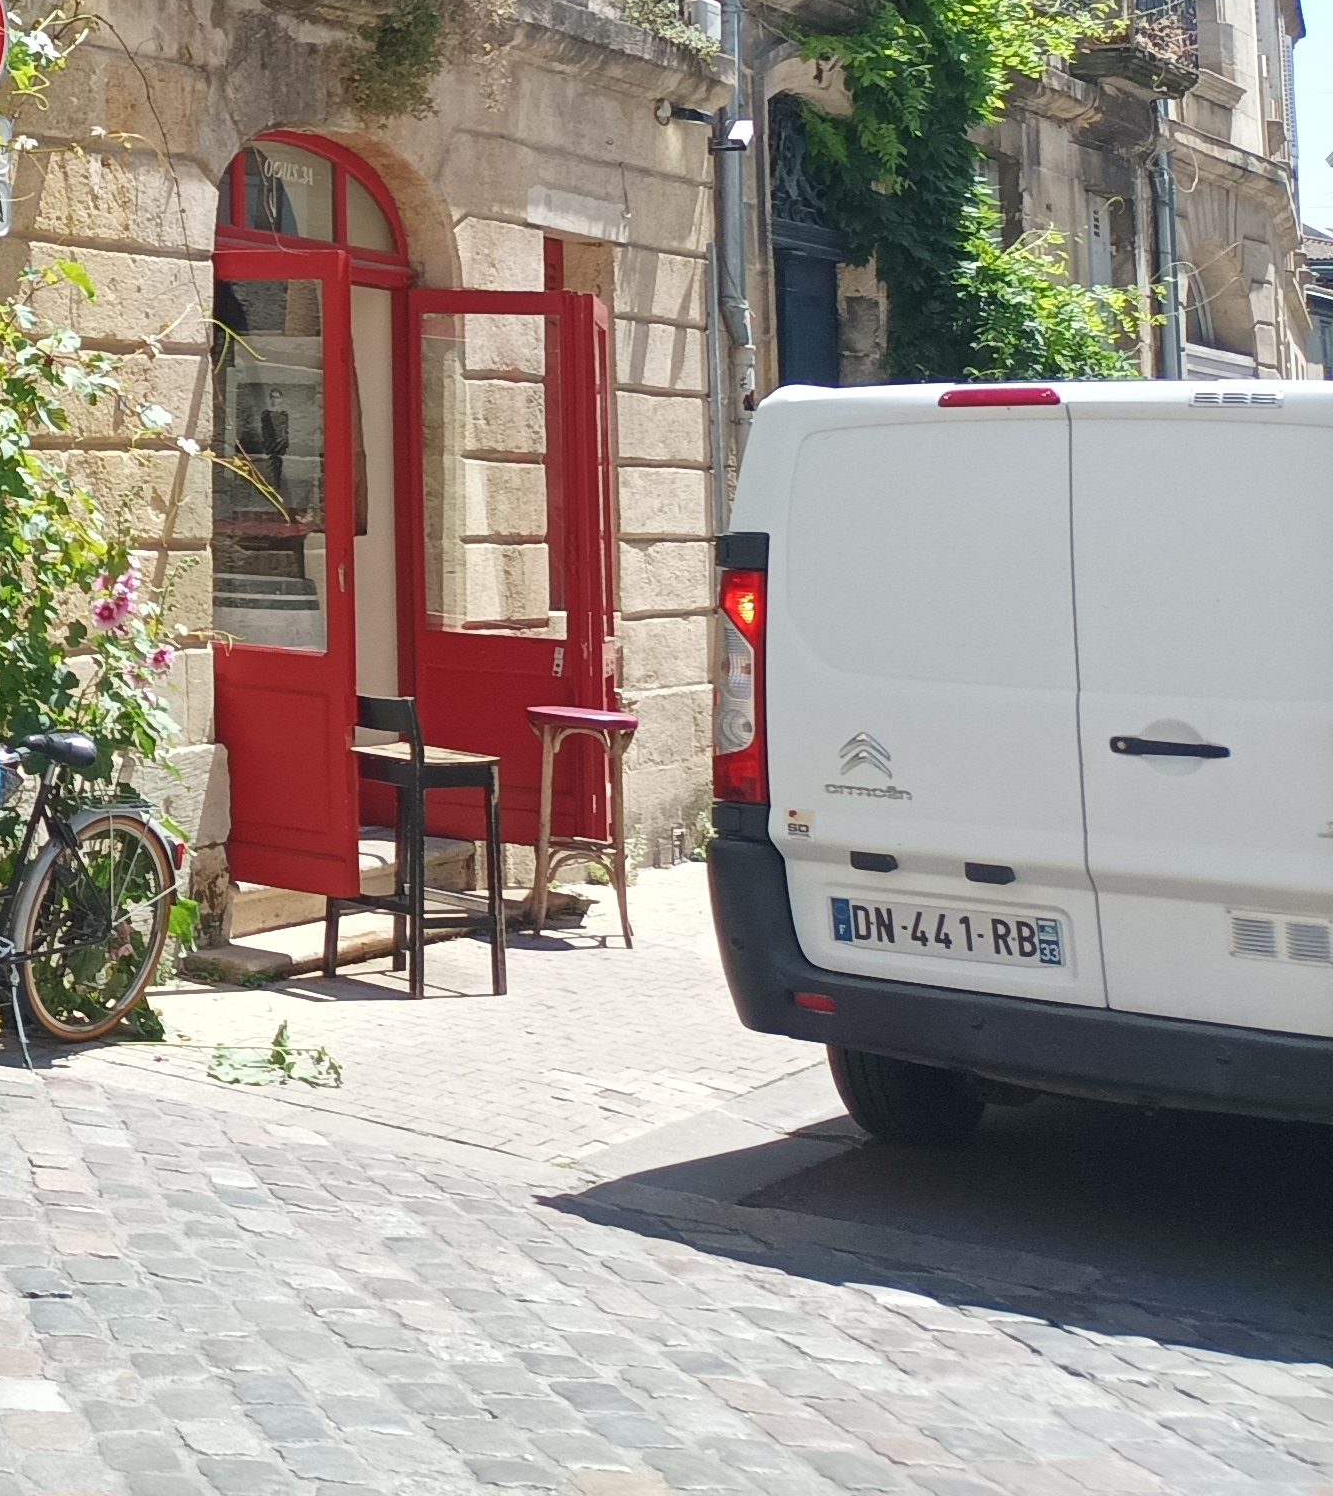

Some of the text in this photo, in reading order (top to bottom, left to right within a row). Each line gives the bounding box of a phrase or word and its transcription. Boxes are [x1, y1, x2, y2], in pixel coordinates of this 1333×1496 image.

[838, 904, 1060, 963] F DN-441-RB 33
